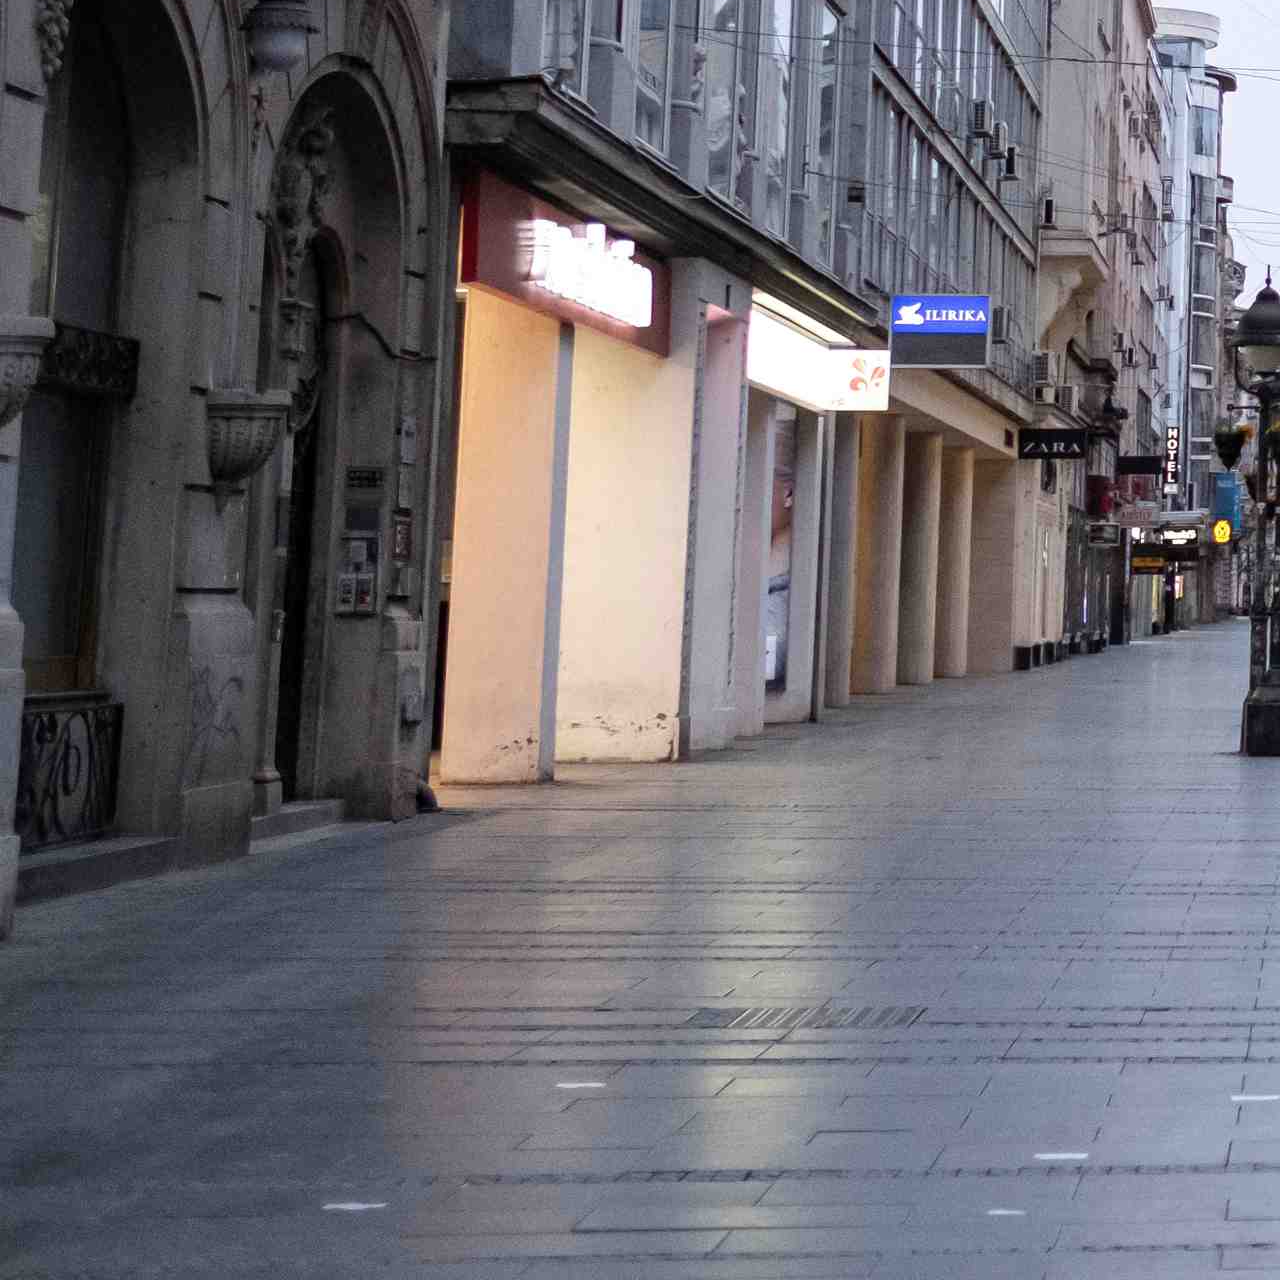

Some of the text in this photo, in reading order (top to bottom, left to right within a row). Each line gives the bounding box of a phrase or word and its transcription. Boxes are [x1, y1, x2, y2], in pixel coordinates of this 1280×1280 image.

[925, 309, 987, 322] ILIRIKA
[1023, 441, 1081, 453] ZARA
[1166, 427, 1179, 483] HOTEL
